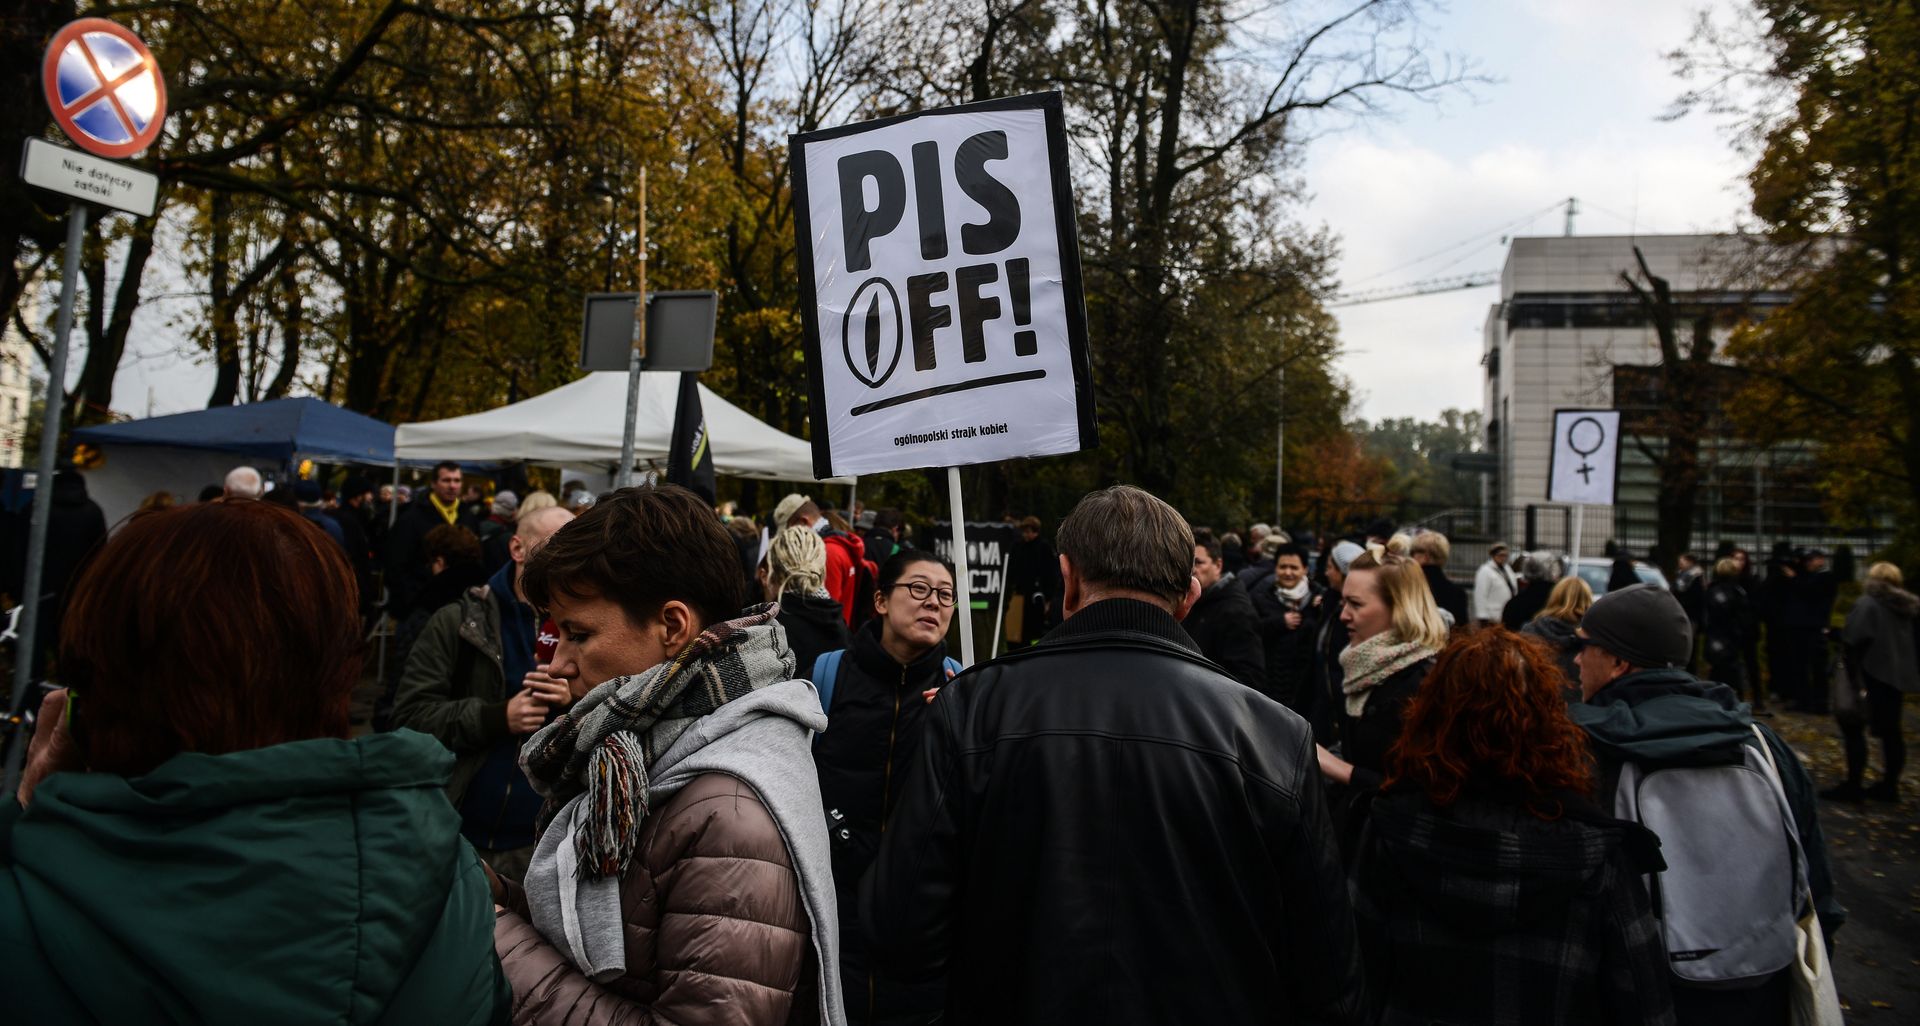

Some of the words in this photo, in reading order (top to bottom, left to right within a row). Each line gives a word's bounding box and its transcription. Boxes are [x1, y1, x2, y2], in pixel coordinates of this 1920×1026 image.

[62, 159, 83, 173] Nie
[88, 168, 133, 191] dotyczy
[837, 130, 1021, 273] PIS
[842, 257, 1038, 388] OFF!
[894, 429, 949, 447] ogólnopolski
[951, 426, 978, 440] strajk
[980, 422, 1009, 436] kobiet
[967, 569, 1000, 594] CJA
